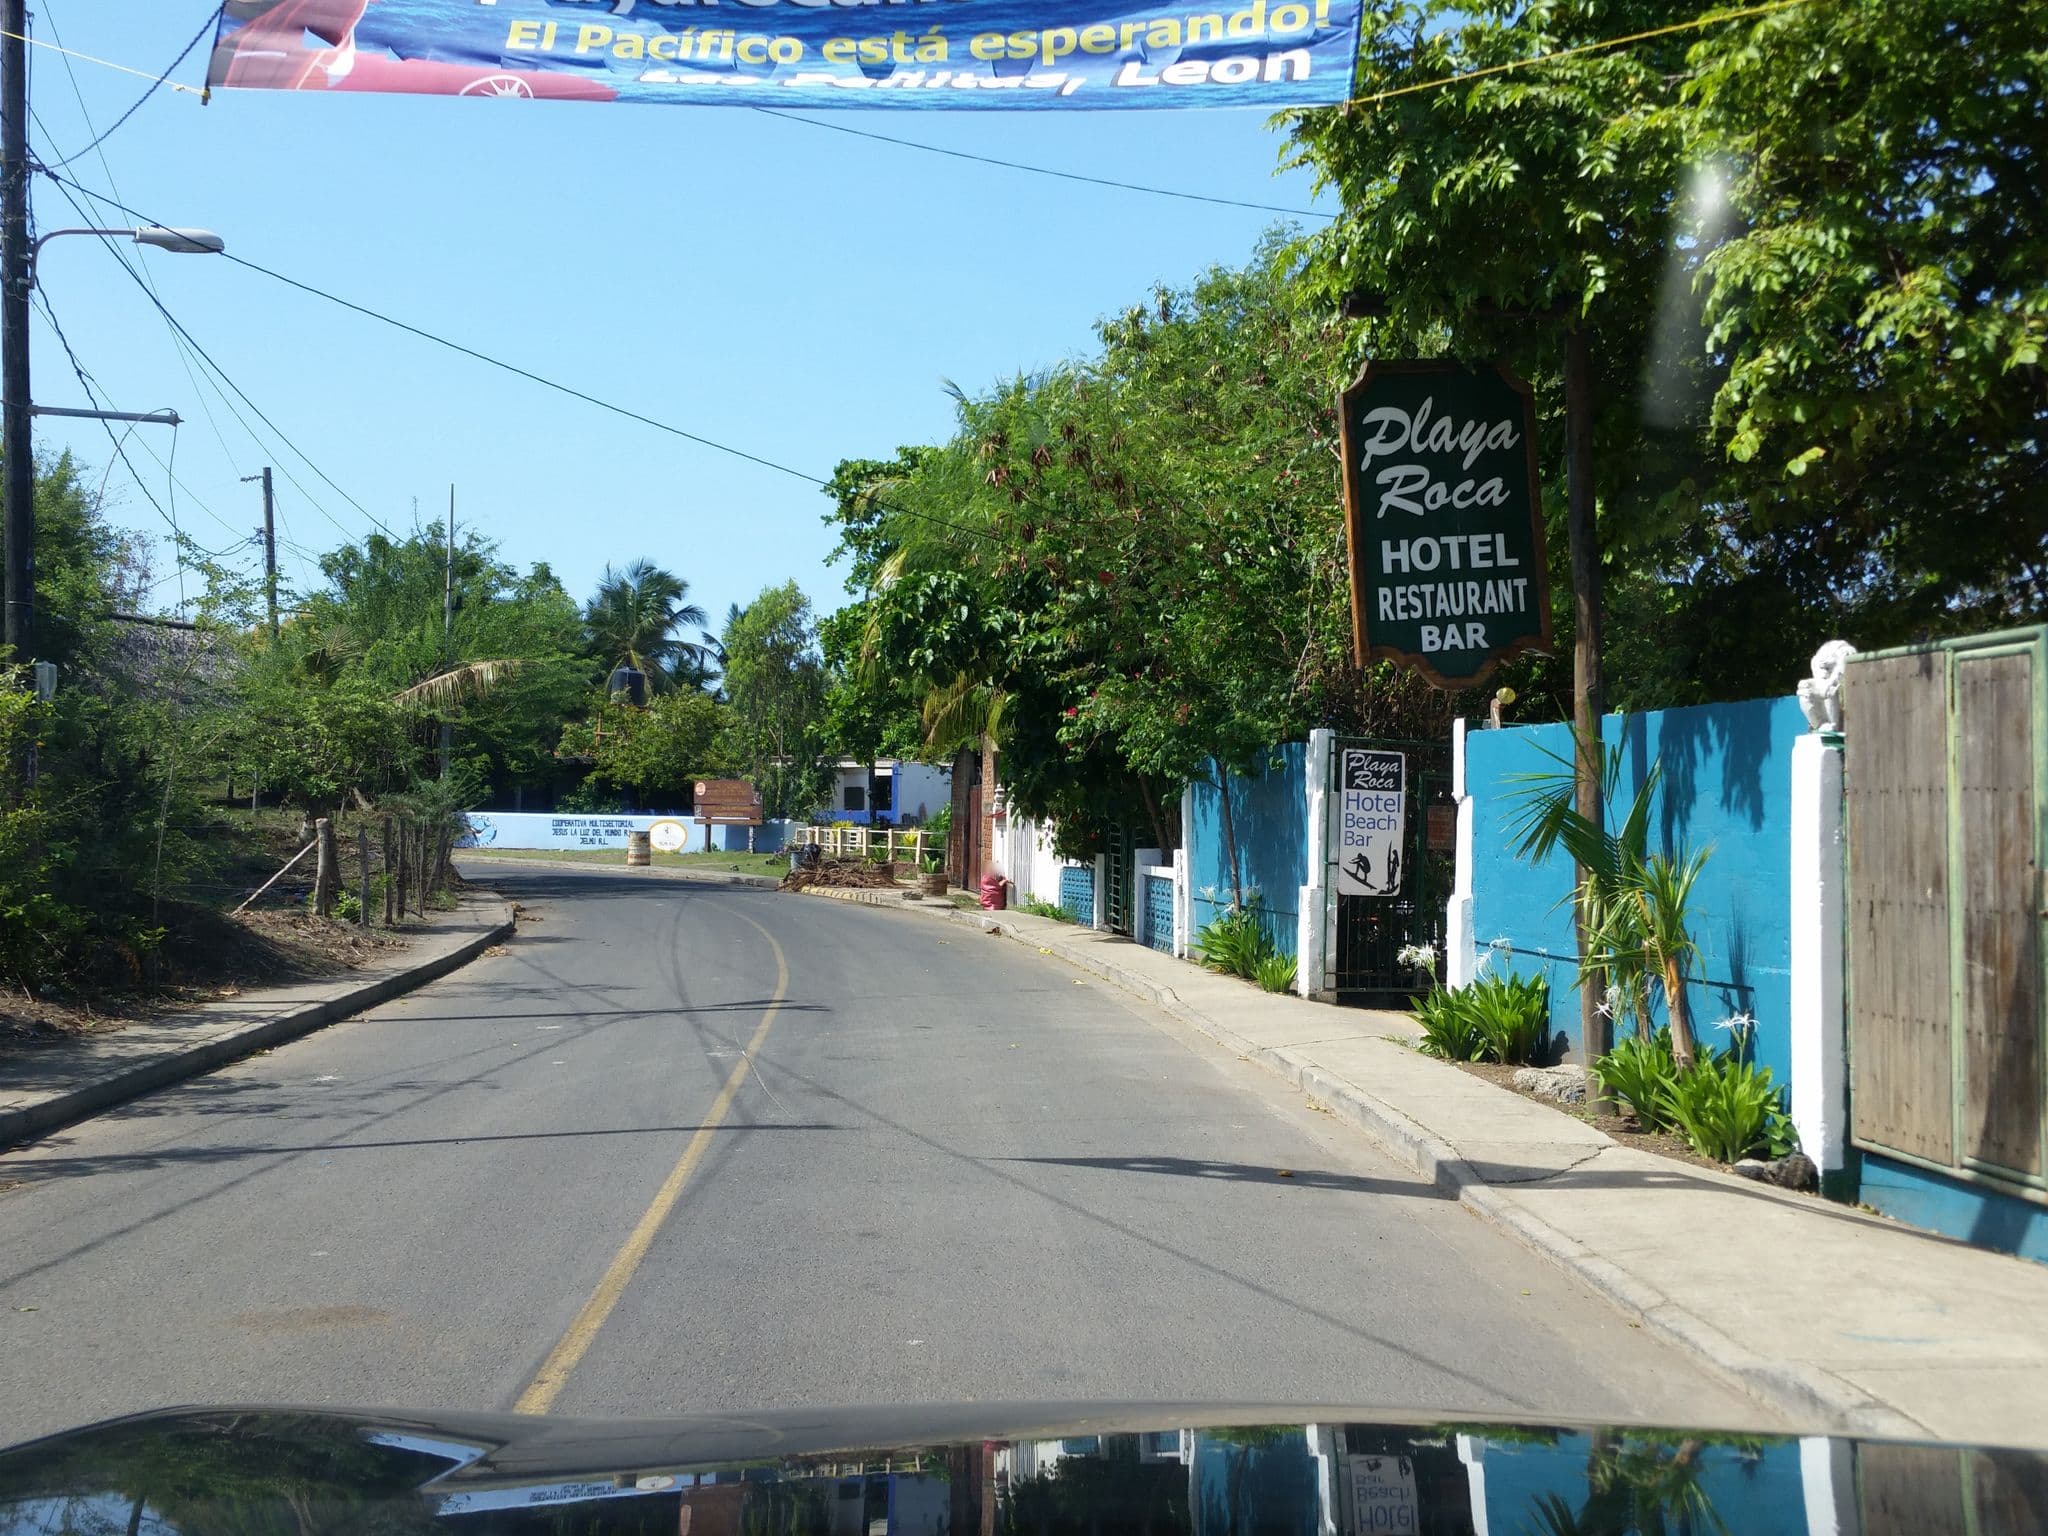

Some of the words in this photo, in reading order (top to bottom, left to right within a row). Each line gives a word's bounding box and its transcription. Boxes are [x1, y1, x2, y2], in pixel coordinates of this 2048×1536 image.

[504, 20, 558, 51] El
[574, 24, 804, 65] Pacífico
[822, 24, 949, 65] está
[968, 0, 1331, 67] esperando!
[1112, 48, 1312, 87] Leon
[1361, 395, 1521, 472] Playa
[1375, 464, 1511, 519] Roca
[1381, 532, 1520, 575] HOTEL
[1378, 577, 1528, 622] RESTAURANT
[1420, 622, 1490, 653] BAR
[1347, 752, 1400, 775] Playa
[1353, 770, 1396, 789] Roca
[1345, 791, 1401, 813] Hotel
[551, 819, 587, 828] COOPERATIVA
[570, 828, 577, 836] LA
[580, 828, 590, 837] LUZ
[592, 828, 602, 837] DEL
[1345, 813, 1397, 831] Beach
[1344, 830, 1373, 847] Bar
